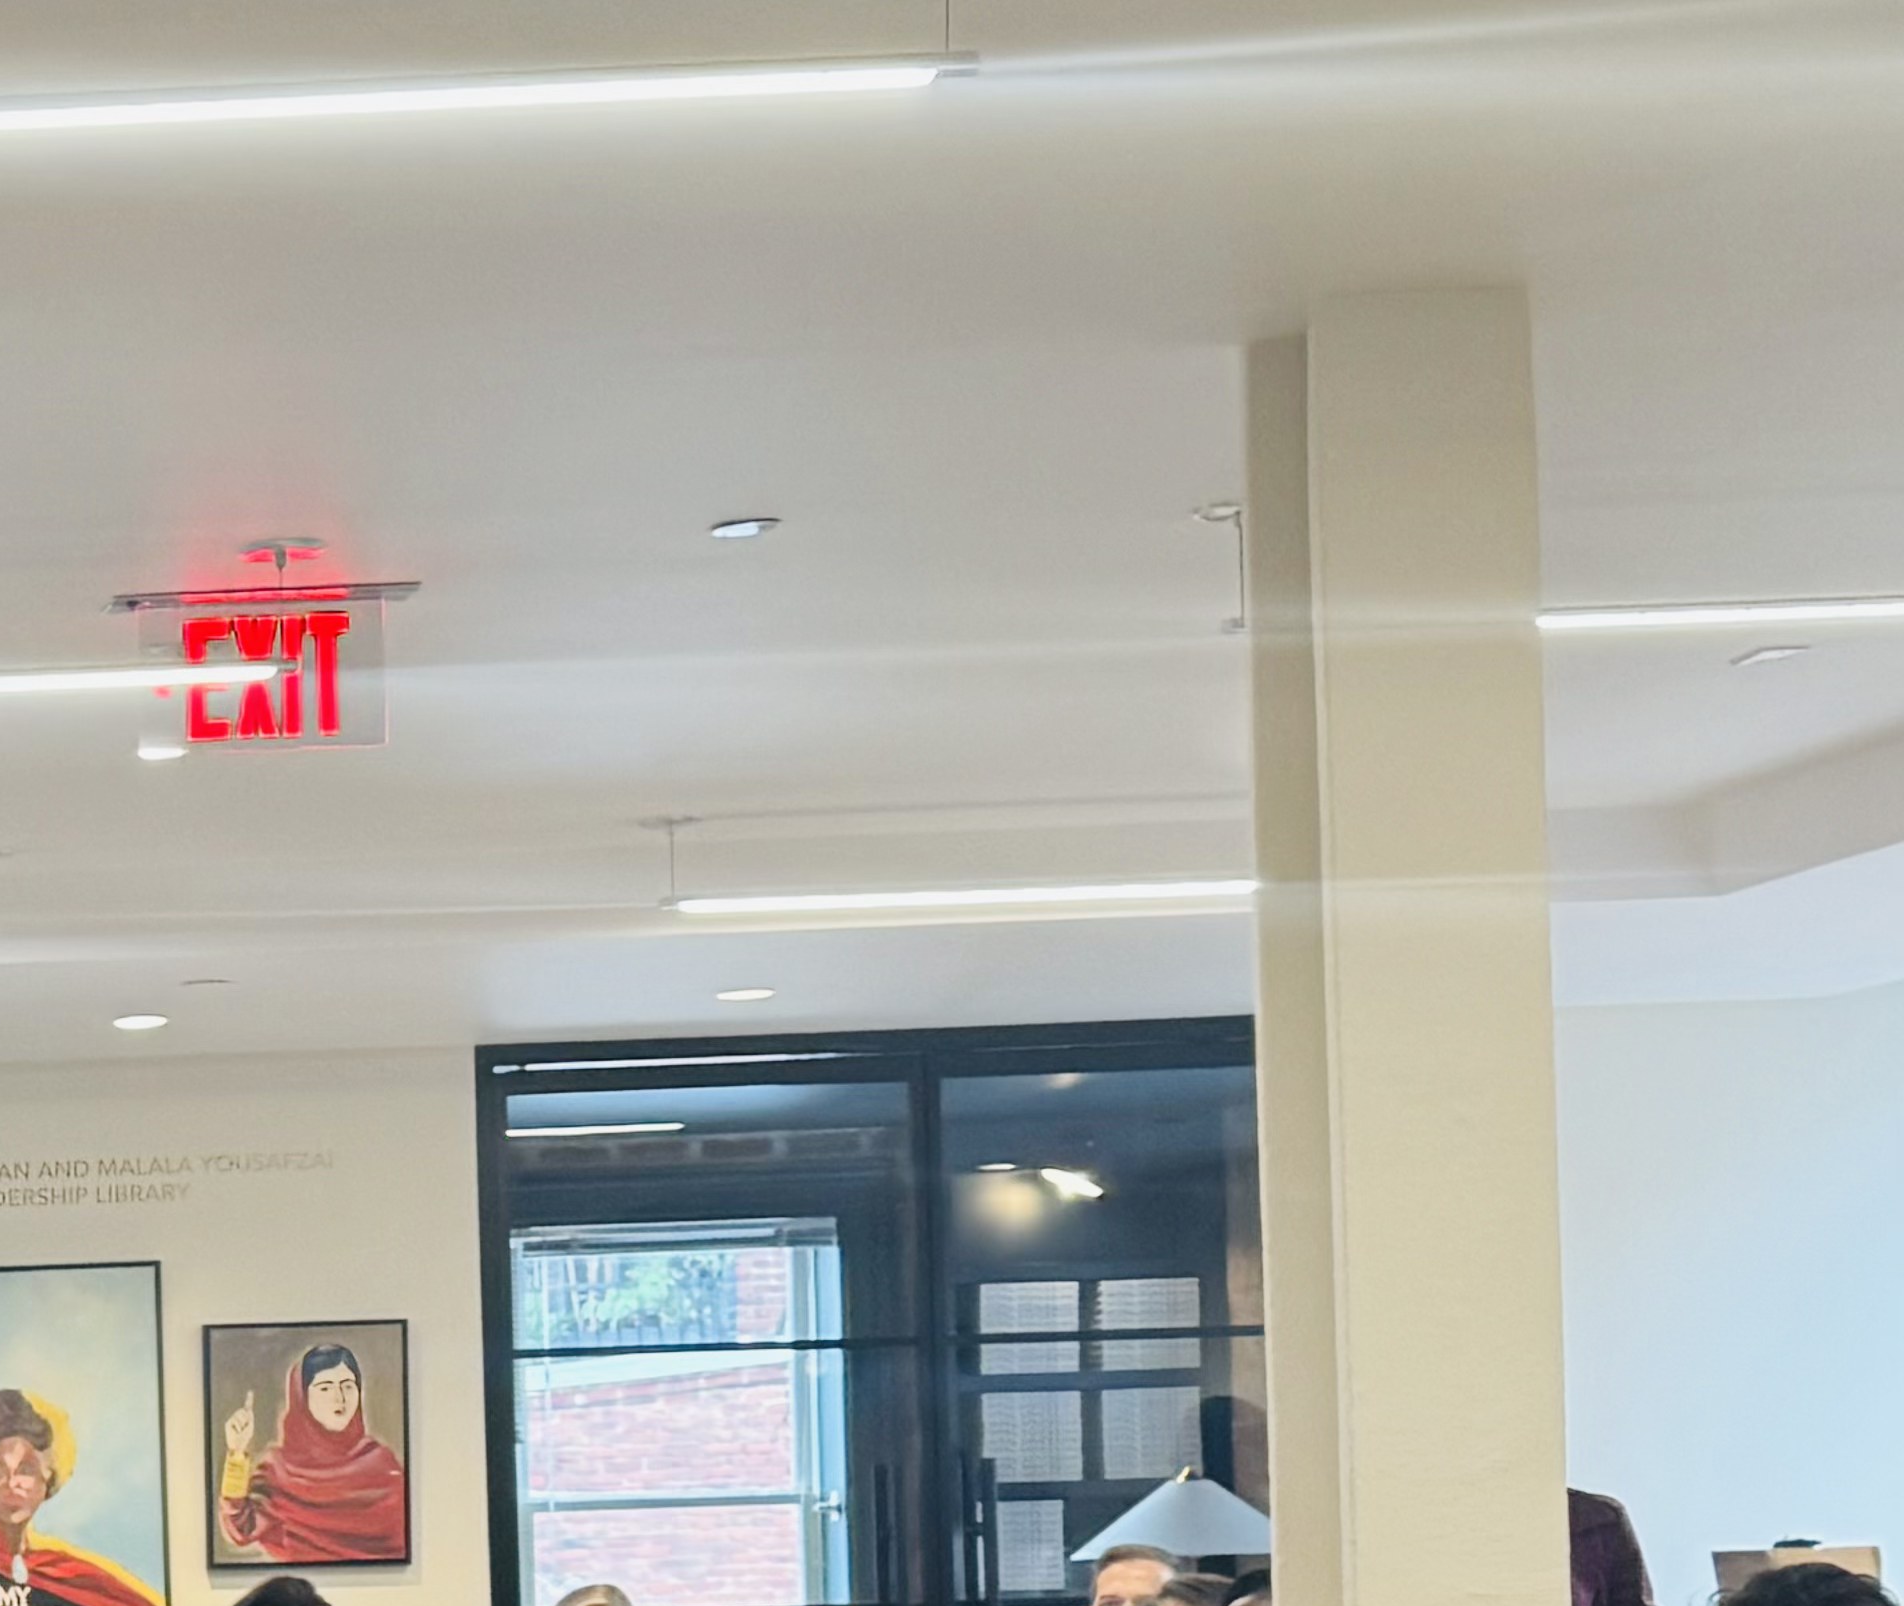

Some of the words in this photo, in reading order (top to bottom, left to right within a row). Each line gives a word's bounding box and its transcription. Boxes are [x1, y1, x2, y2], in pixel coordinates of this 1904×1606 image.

[182, 610, 349, 742] EXIT
[38, 1159, 90, 1180] AND
[96, 1156, 195, 1177] MALALA
[95, 1182, 190, 1204] LIBRARY
